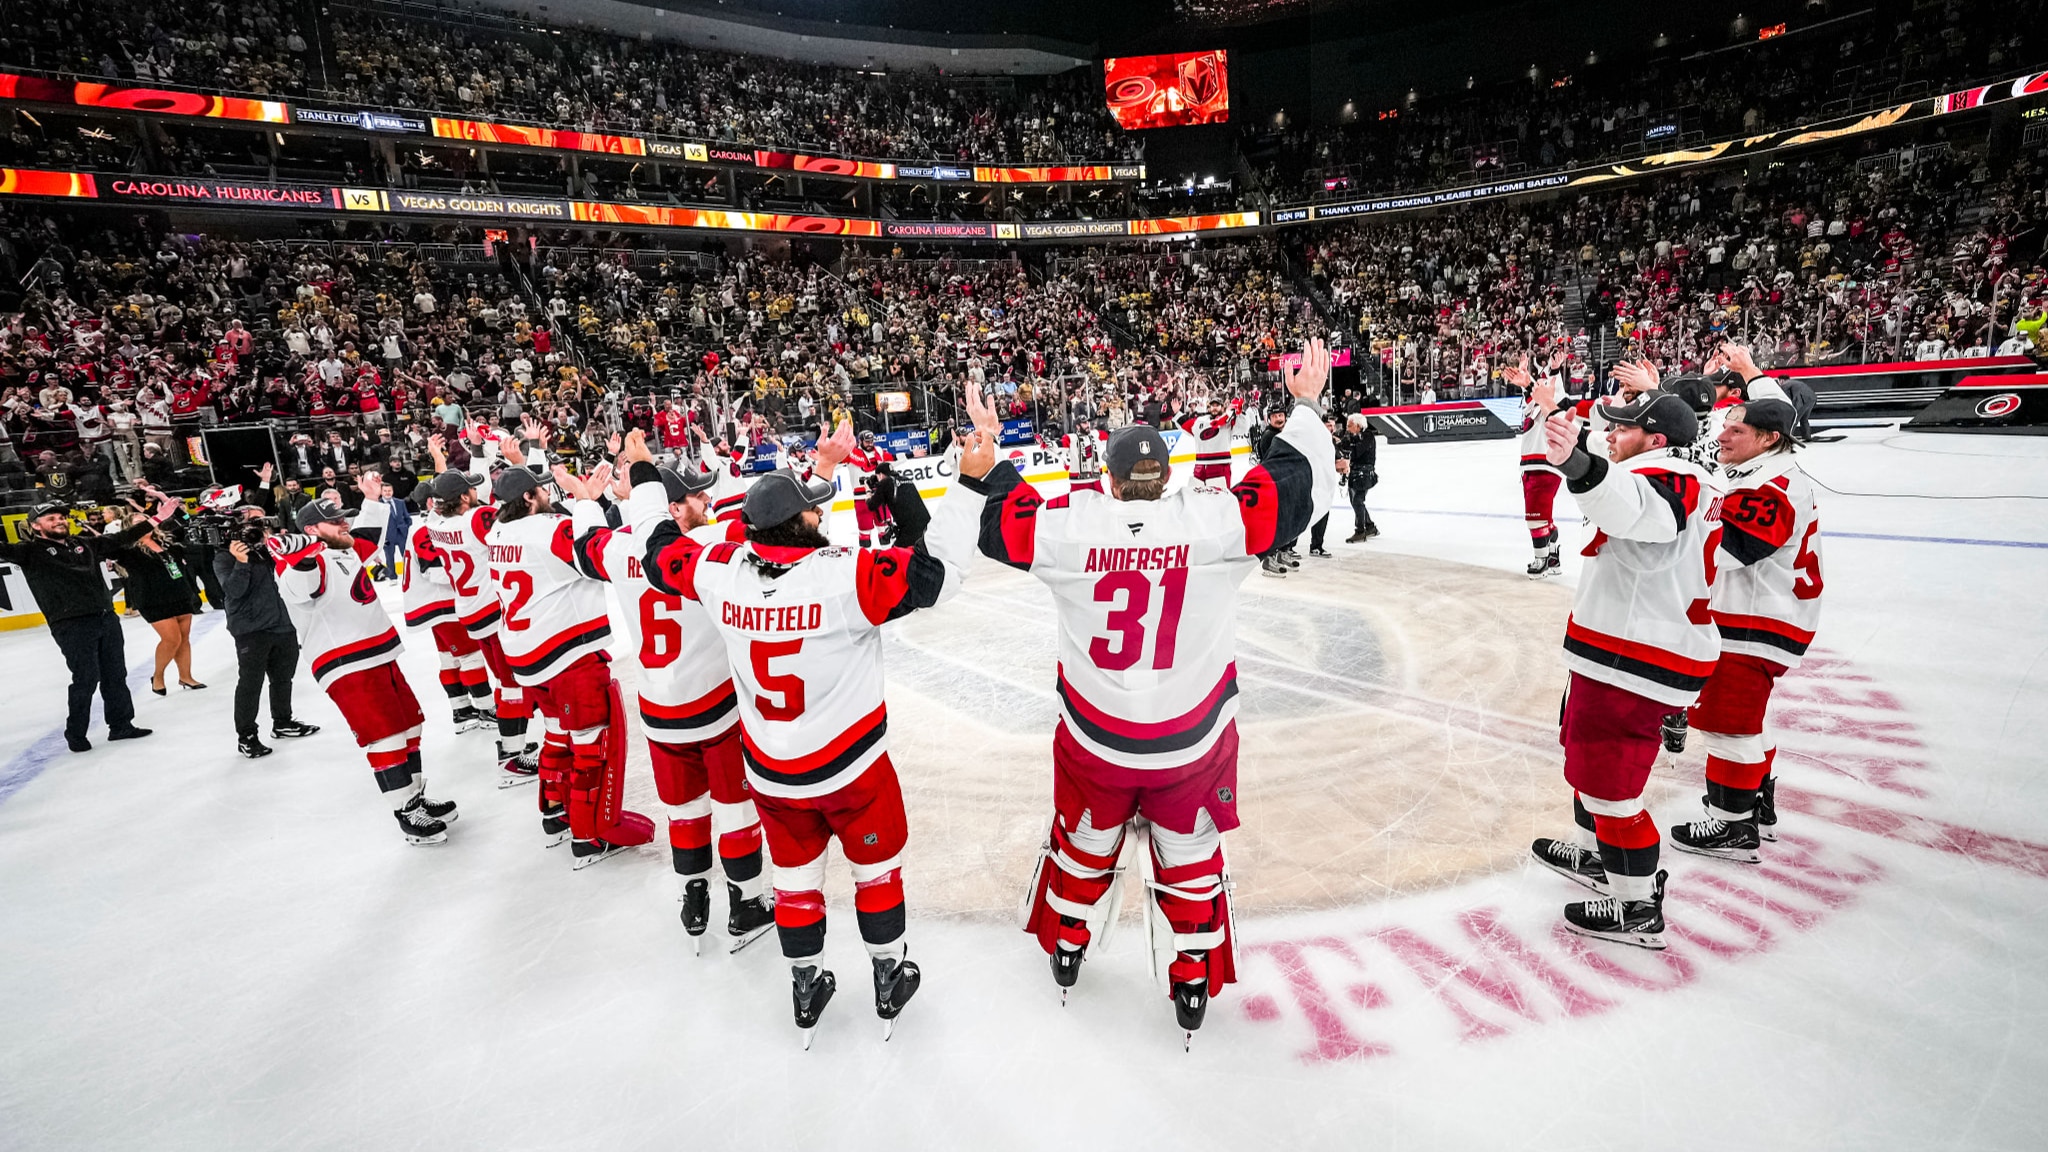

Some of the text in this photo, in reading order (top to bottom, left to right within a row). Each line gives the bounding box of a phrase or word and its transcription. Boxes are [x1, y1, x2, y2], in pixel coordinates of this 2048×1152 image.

[296, 110, 338, 122] STANLEY
[340, 115, 358, 124] CUP
[375, 118, 402, 128] FINAL
[649, 144, 681, 155] VEGAS
[690, 147, 702, 157] VS
[709, 149, 753, 162] CAROLINA
[1114, 168, 1138, 177] VEGAS
[112, 180, 322, 203] CAROLINA HURRICANES
[1320, 175, 1568, 216] THANK YOU FOR COMING, PLEASE GET HOME SAFELY!
[351, 193, 370, 206] VS
[398, 195, 563, 216] VEGAS GOLDEN KNIGHTS
[1295, 211, 1306, 219] PM
[888, 224, 986, 236] CAROLINA HURRICANES
[1001, 227, 1011, 236] VS
[1025, 223, 1123, 236] VEGAS GOLDEN KNIGHTS
[1438, 416, 1487, 426] CHAMPIONS
[889, 438, 908, 447] UMC
[1735, 496, 1779, 527] 53
[1084, 544, 1190, 573] ANDERSEN
[1792, 519, 1824, 600] 5
[722, 600, 822, 632] CHATFIELD
[1088, 566, 1189, 671] 31
[638, 587, 682, 669] 6
[749, 637, 805, 722] 5
[1629, 918, 1656, 933] CCM
